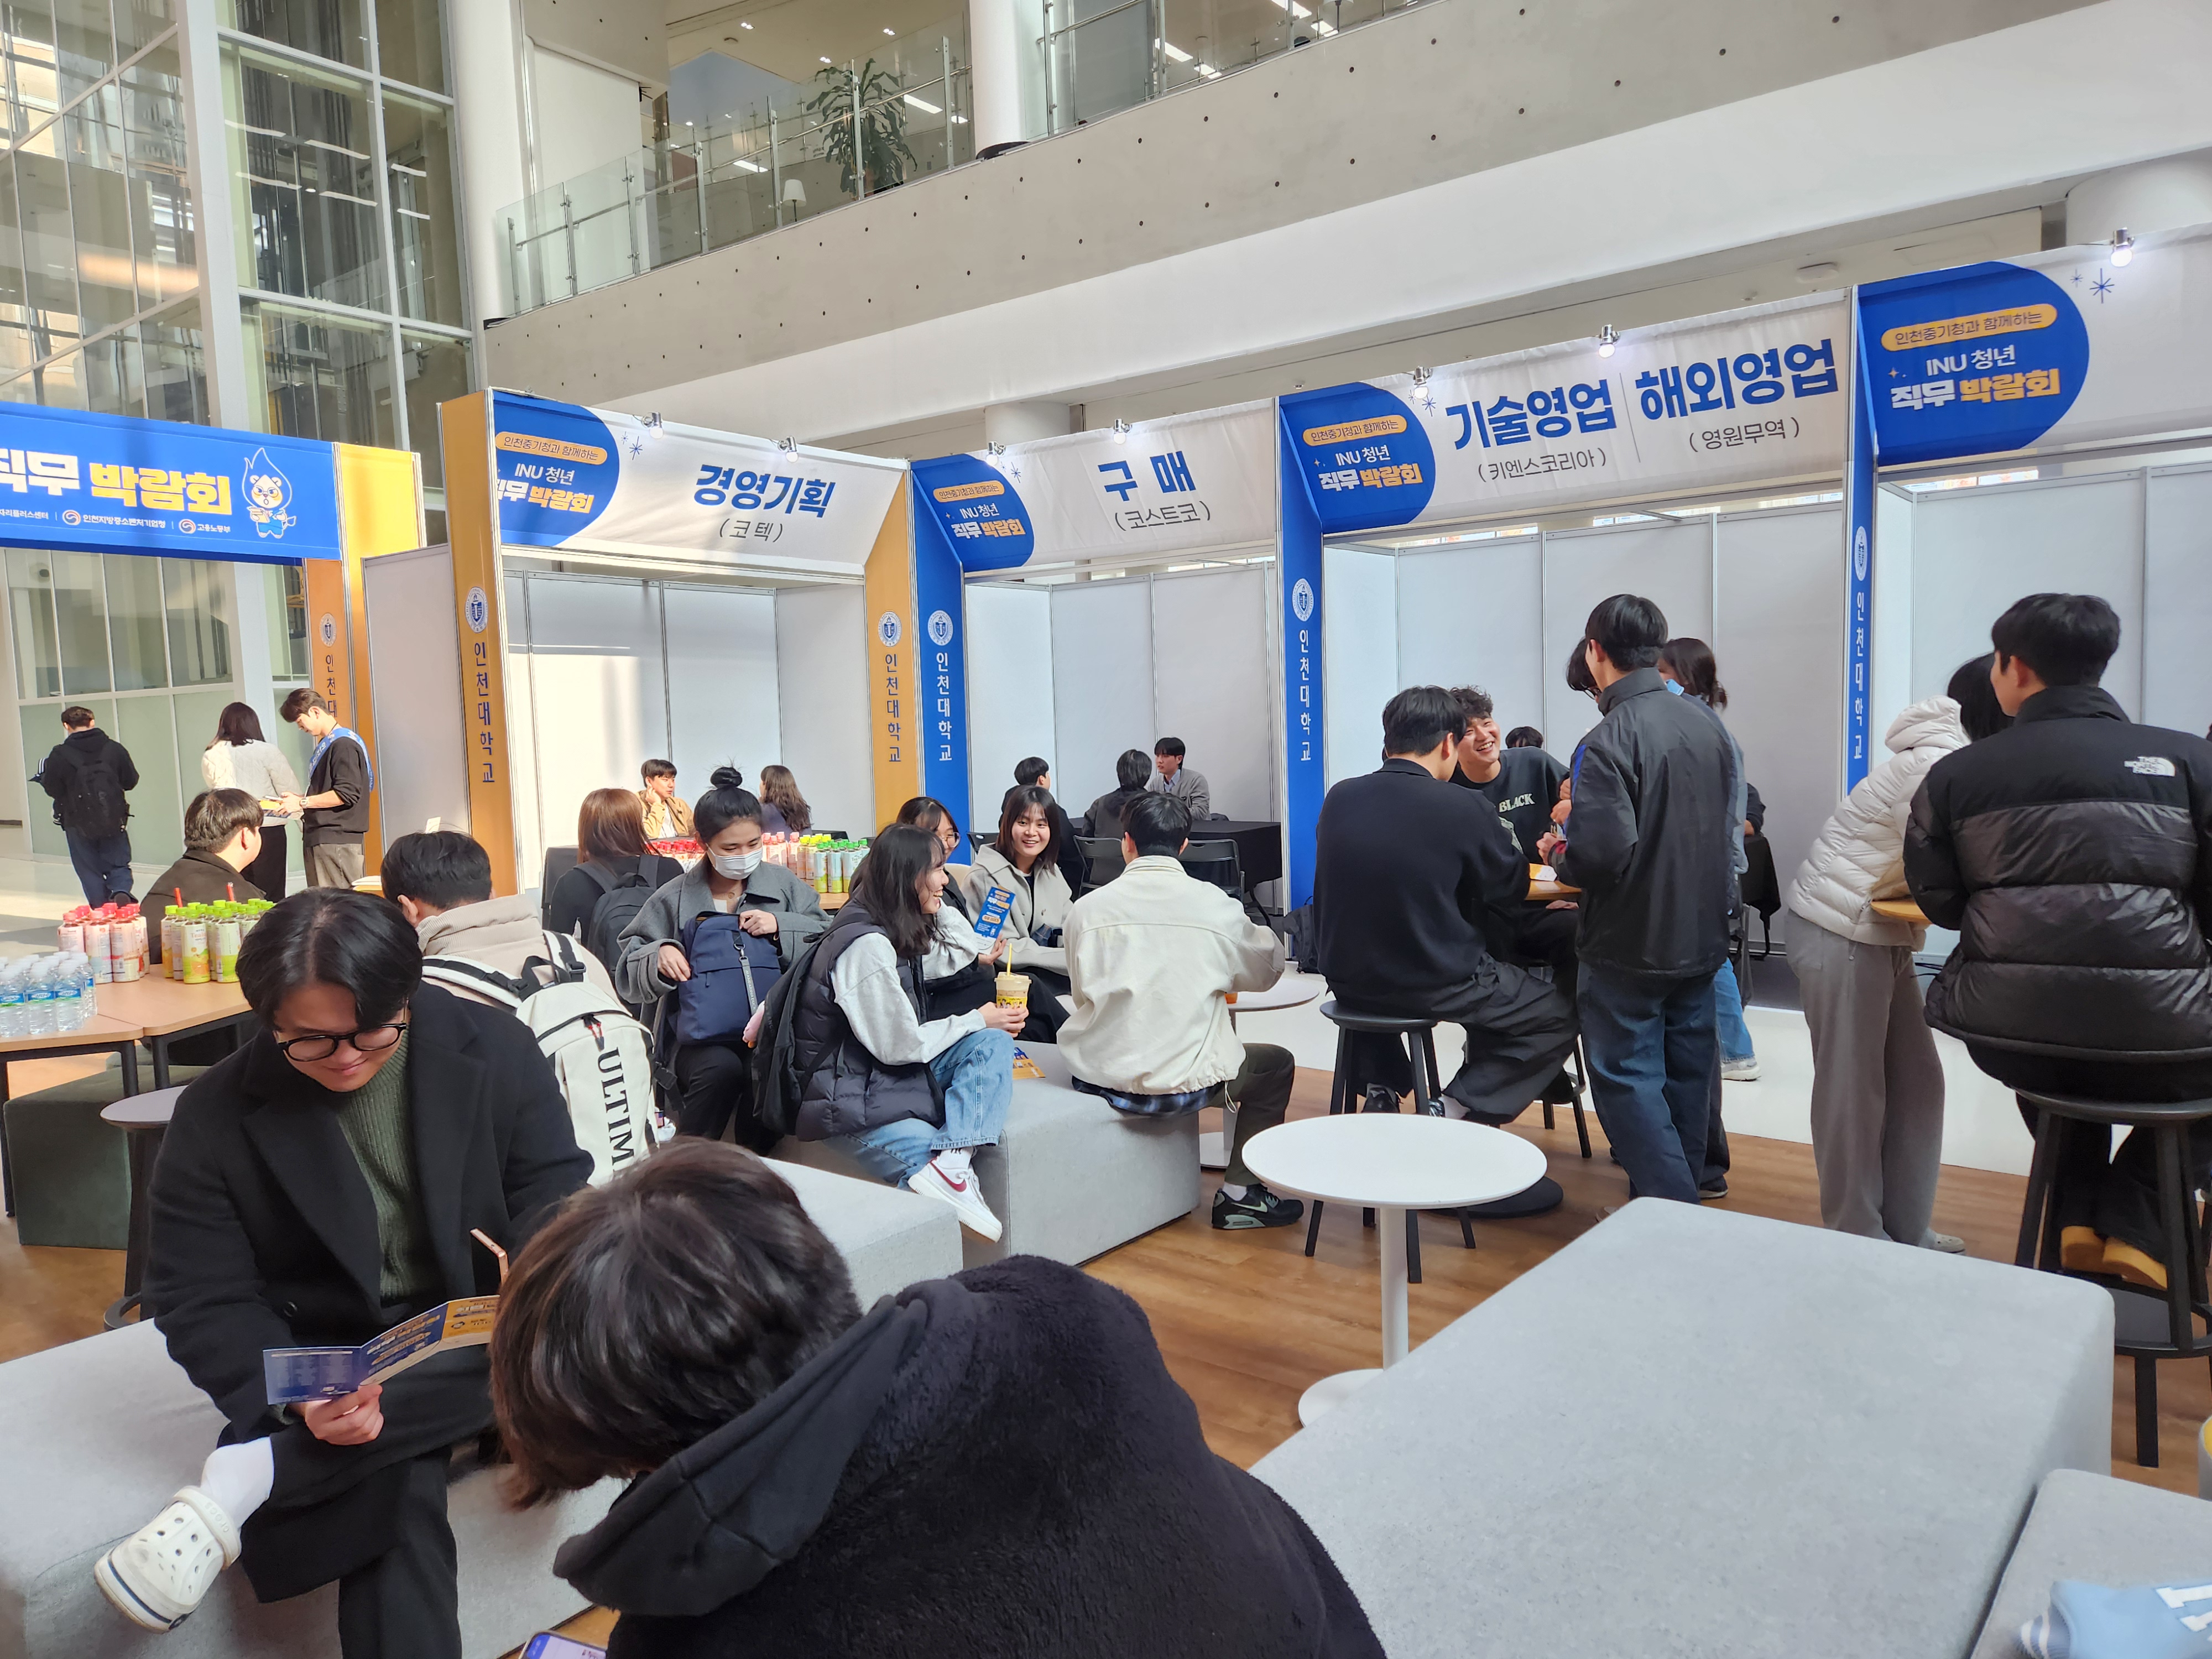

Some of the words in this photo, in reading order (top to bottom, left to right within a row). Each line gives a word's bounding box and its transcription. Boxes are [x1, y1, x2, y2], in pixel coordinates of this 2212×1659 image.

[1895, 320, 1980, 346] 인천중기청과
[1983, 312, 2043, 331] 함께하는
[1635, 338, 1839, 421] 해외영업
[1926, 354, 1967, 377] INU
[1971, 345, 2016, 371] 청년
[1890, 379, 1956, 410] 직무
[1959, 368, 2061, 403] 박람회
[1311, 426, 1362, 442] 인천중기청과
[1363, 419, 1399, 433] 함께하는
[1446, 378, 1618, 450] 기술영업
[504, 436, 561, 454] 인천중기청과
[562, 446, 599, 461] 함께하는
[1335, 451, 1361, 466] INU
[1361, 445, 1391, 463] 청년
[89, 462, 232, 515] 박람회
[514, 463, 544, 479] INU
[545, 466, 575, 486] 청년
[694, 464, 836, 518] 경영기획
[1318, 469, 1360, 492] 직무
[1359, 463, 1423, 488] 박람회
[528, 486, 594, 514] 박람회
[959, 507, 979, 519] INU
[977, 503, 1000, 518] 청년
[951, 521, 983, 539] 직무
[980, 519, 1026, 538] 박람회
[1853, 591, 1865, 760] 인천대학교
[474, 641, 495, 783] 인천대학교
[885, 653, 901, 763] 인천대학교
[936, 652, 952, 761] 인천대학교
[1299, 629, 1311, 761] 인천대학교
[1499, 793, 1535, 813] BLACK
[597, 1047, 635, 1168] ULTIM
